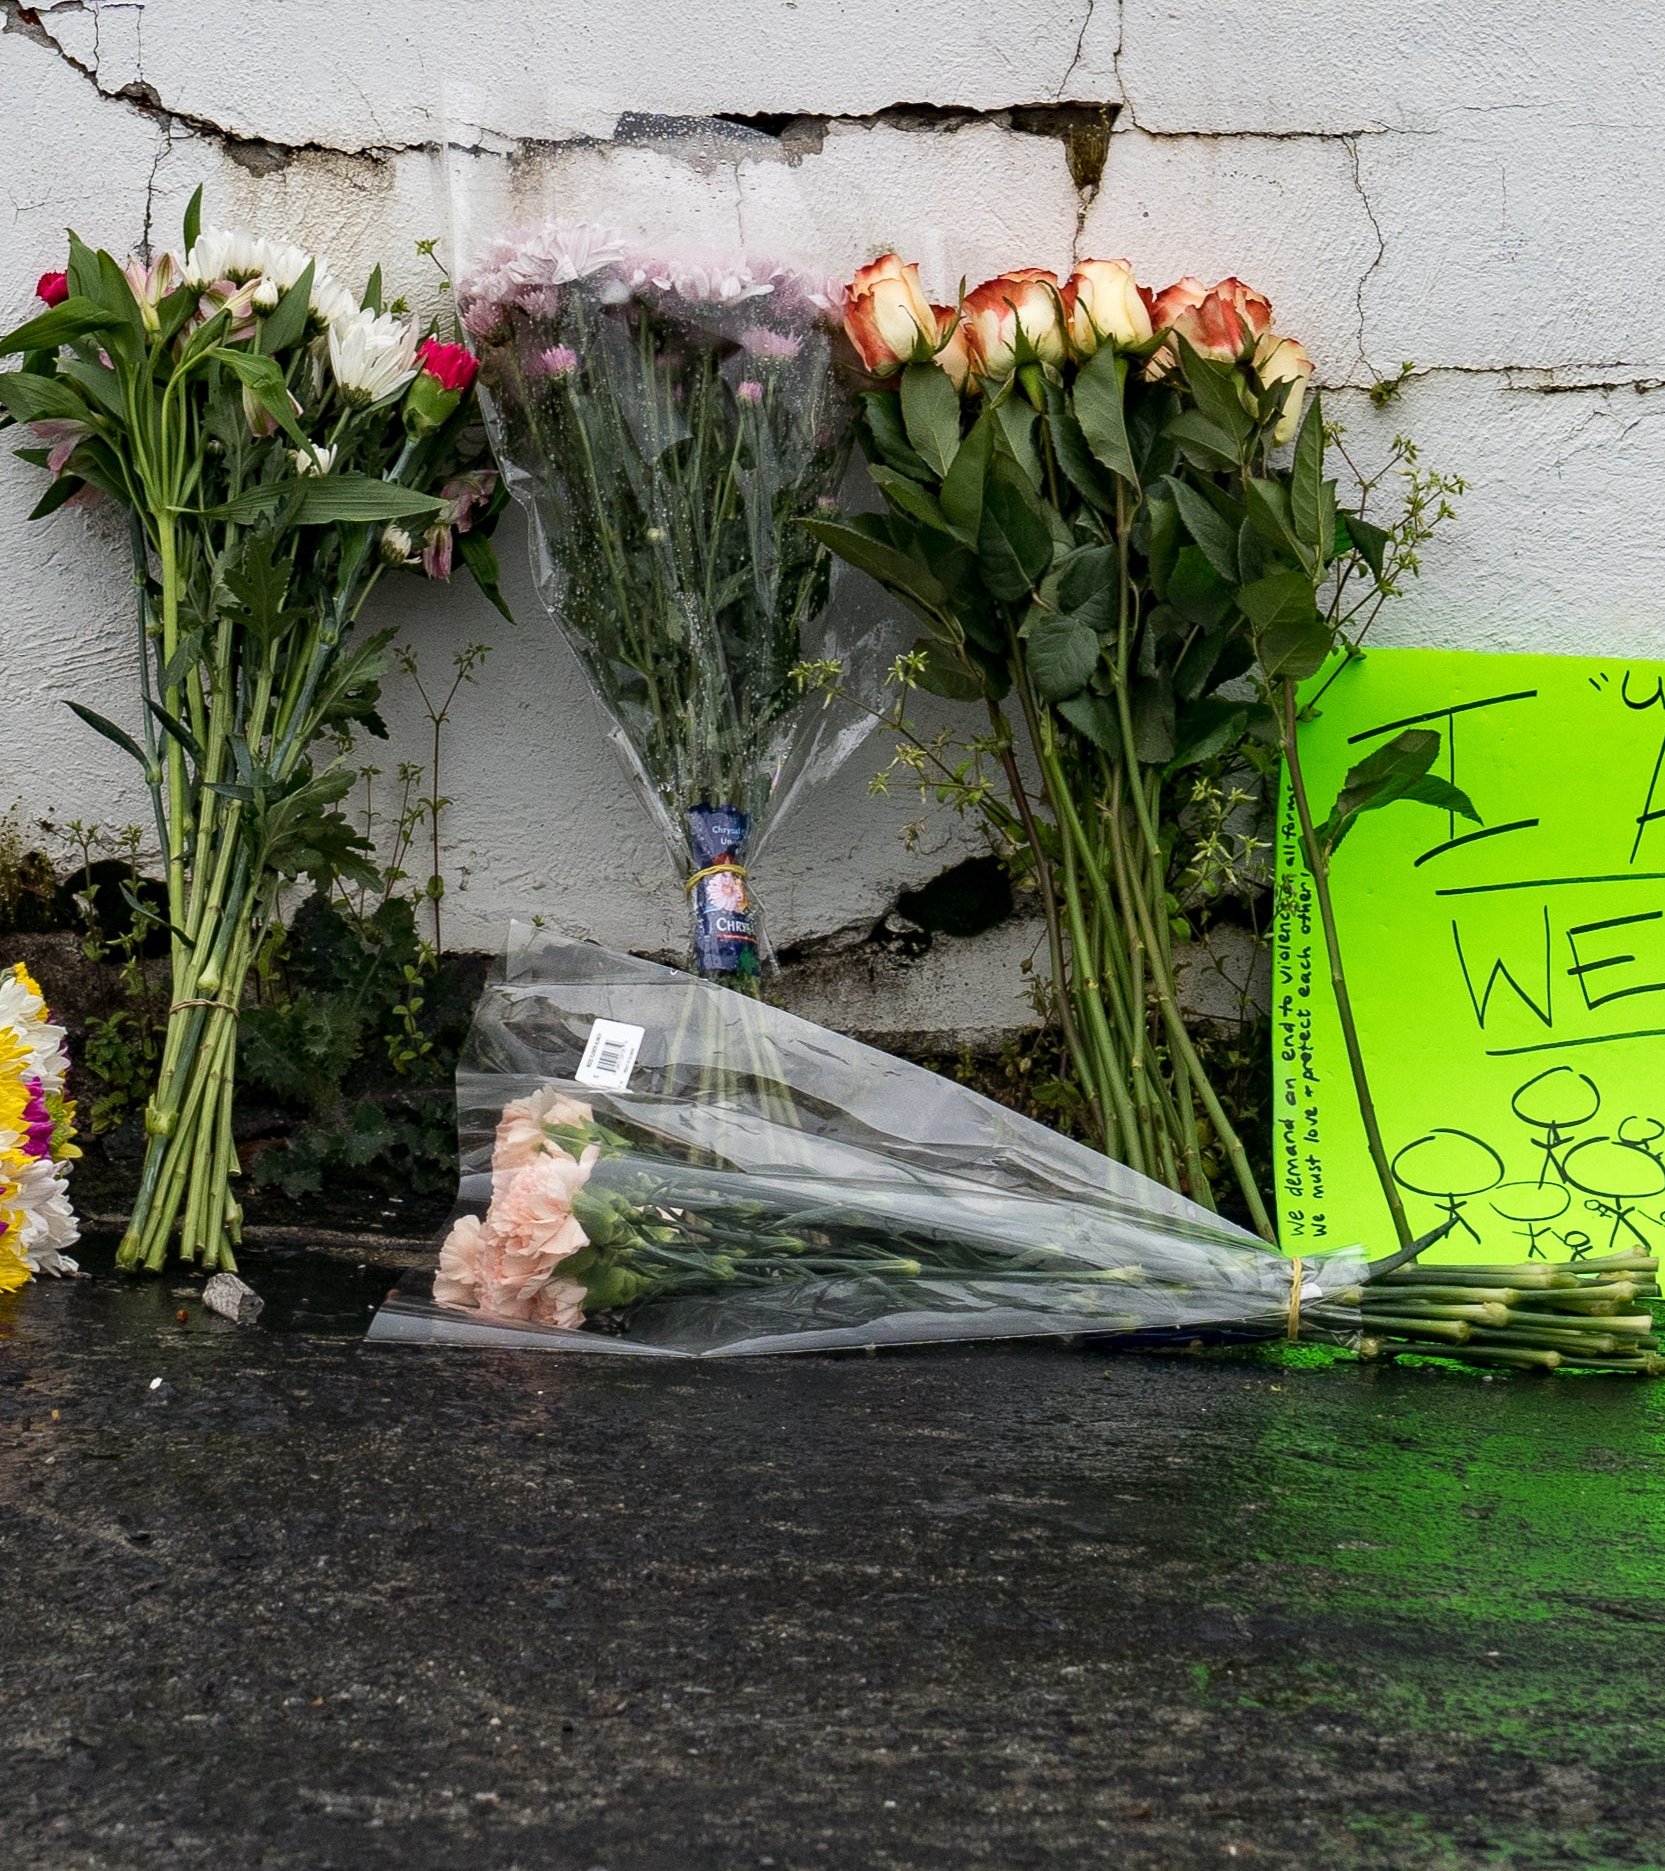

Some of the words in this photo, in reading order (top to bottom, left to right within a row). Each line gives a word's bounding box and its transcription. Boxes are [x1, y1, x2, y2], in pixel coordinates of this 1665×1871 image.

[1347, 689, 1540, 868] I
[1282, 844, 1296, 867] all
[1276, 904, 1292, 985] violenc
[1297, 946, 1311, 998] each
[1278, 995, 1293, 1017] to
[1278, 1022, 1295, 1061] end
[1297, 1008, 1321, 1082] protect
[1284, 1078, 1296, 1106] an
[1302, 1106, 1320, 1143] love
[1278, 1119, 1304, 1197] demand
[1306, 1154, 1324, 1198] must
